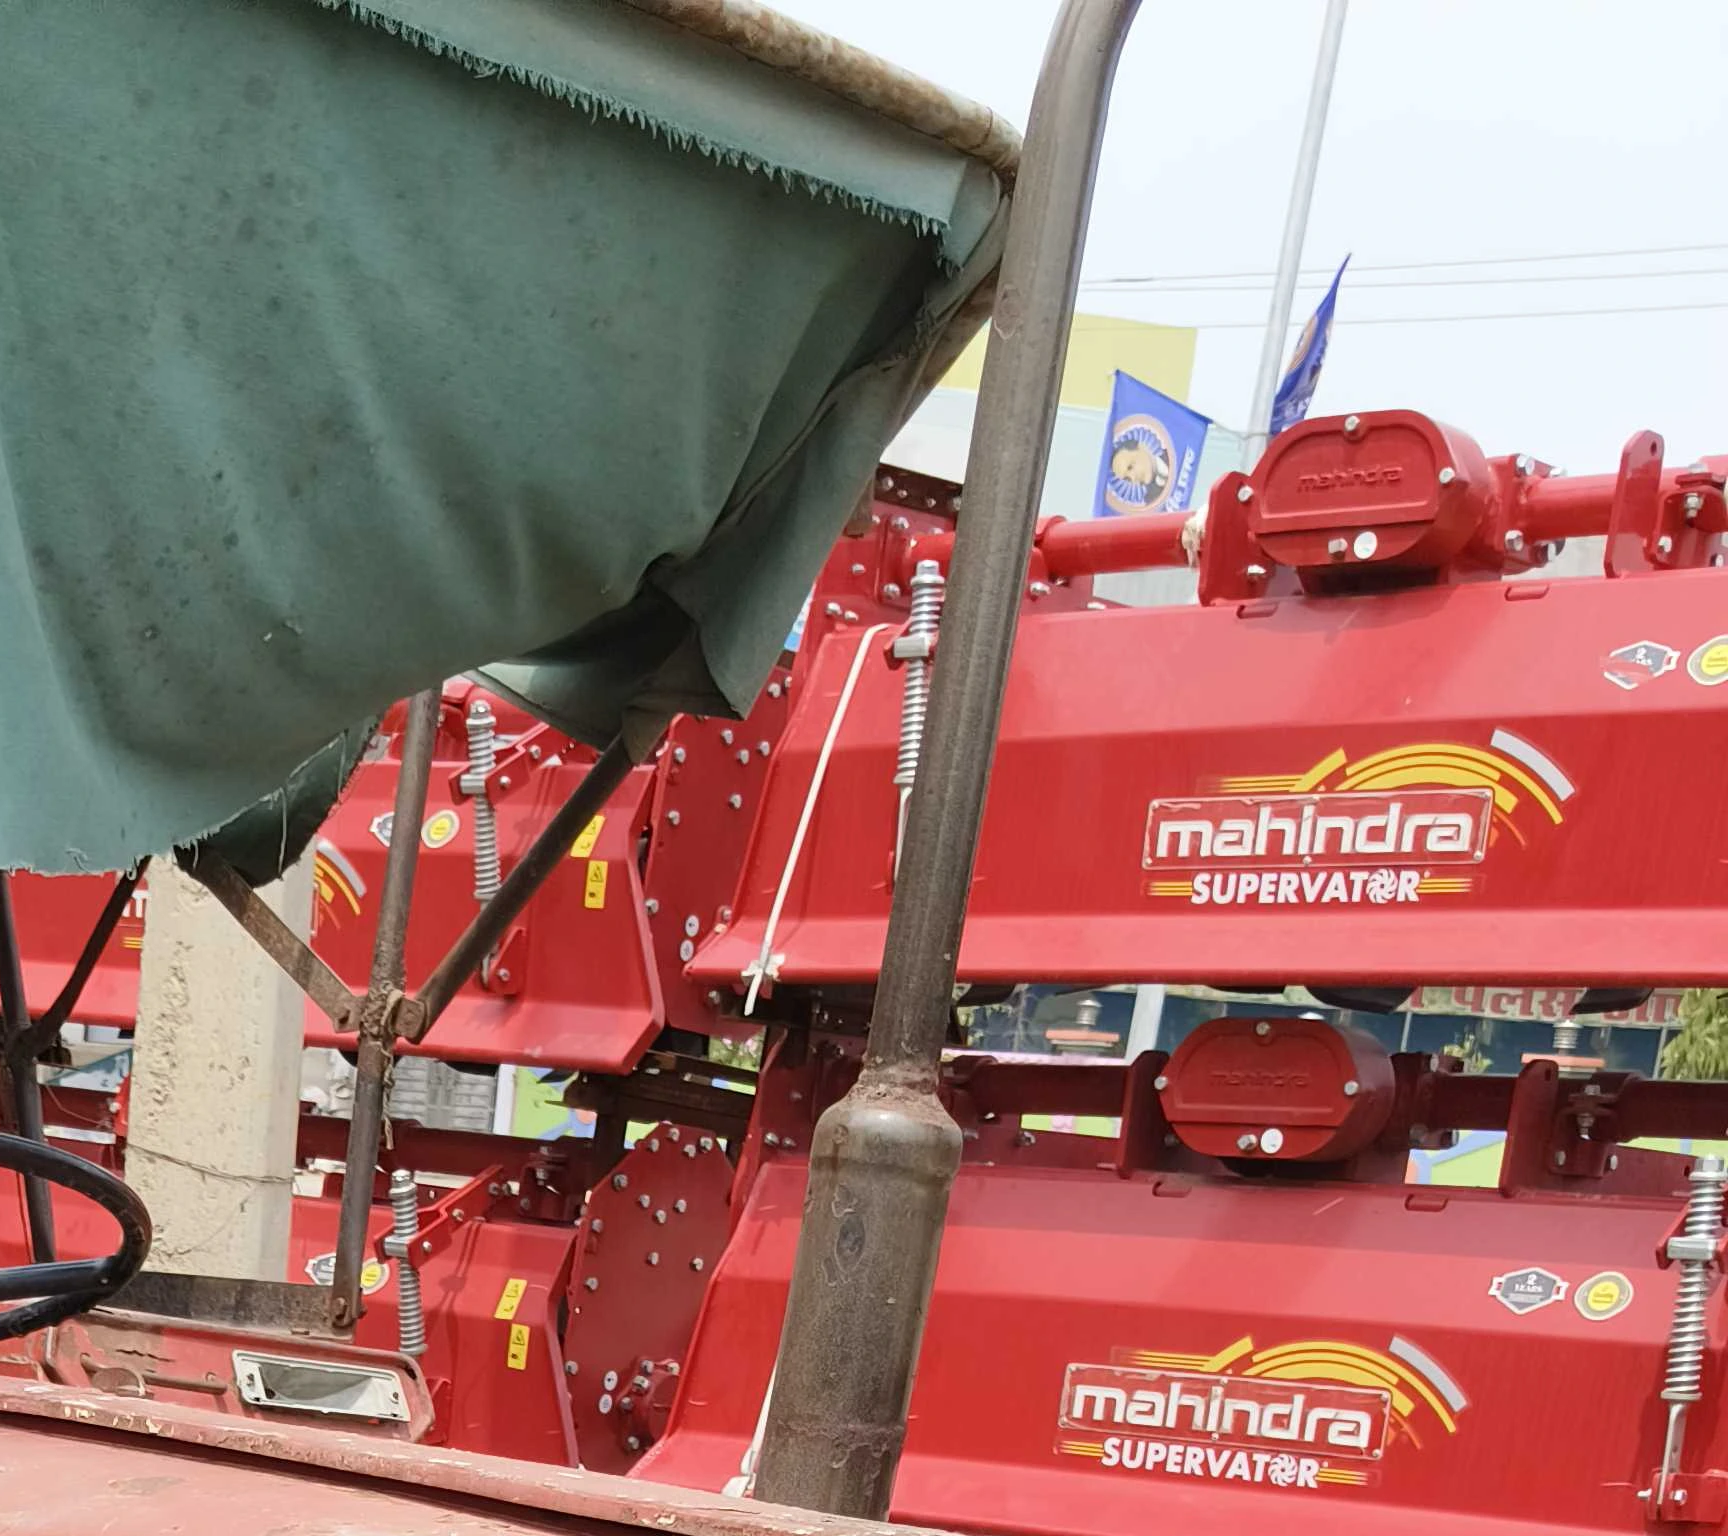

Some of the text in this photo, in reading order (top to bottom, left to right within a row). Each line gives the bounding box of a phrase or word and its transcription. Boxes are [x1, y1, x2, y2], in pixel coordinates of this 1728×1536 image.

[1294, 463, 1405, 494] mahindra
[1155, 802, 1473, 858] mahindra
[1190, 868, 1421, 904] SUPERVATOR
[1072, 1382, 1372, 1448] mahindra
[1100, 1436, 1322, 1489] SUPERVATOR
